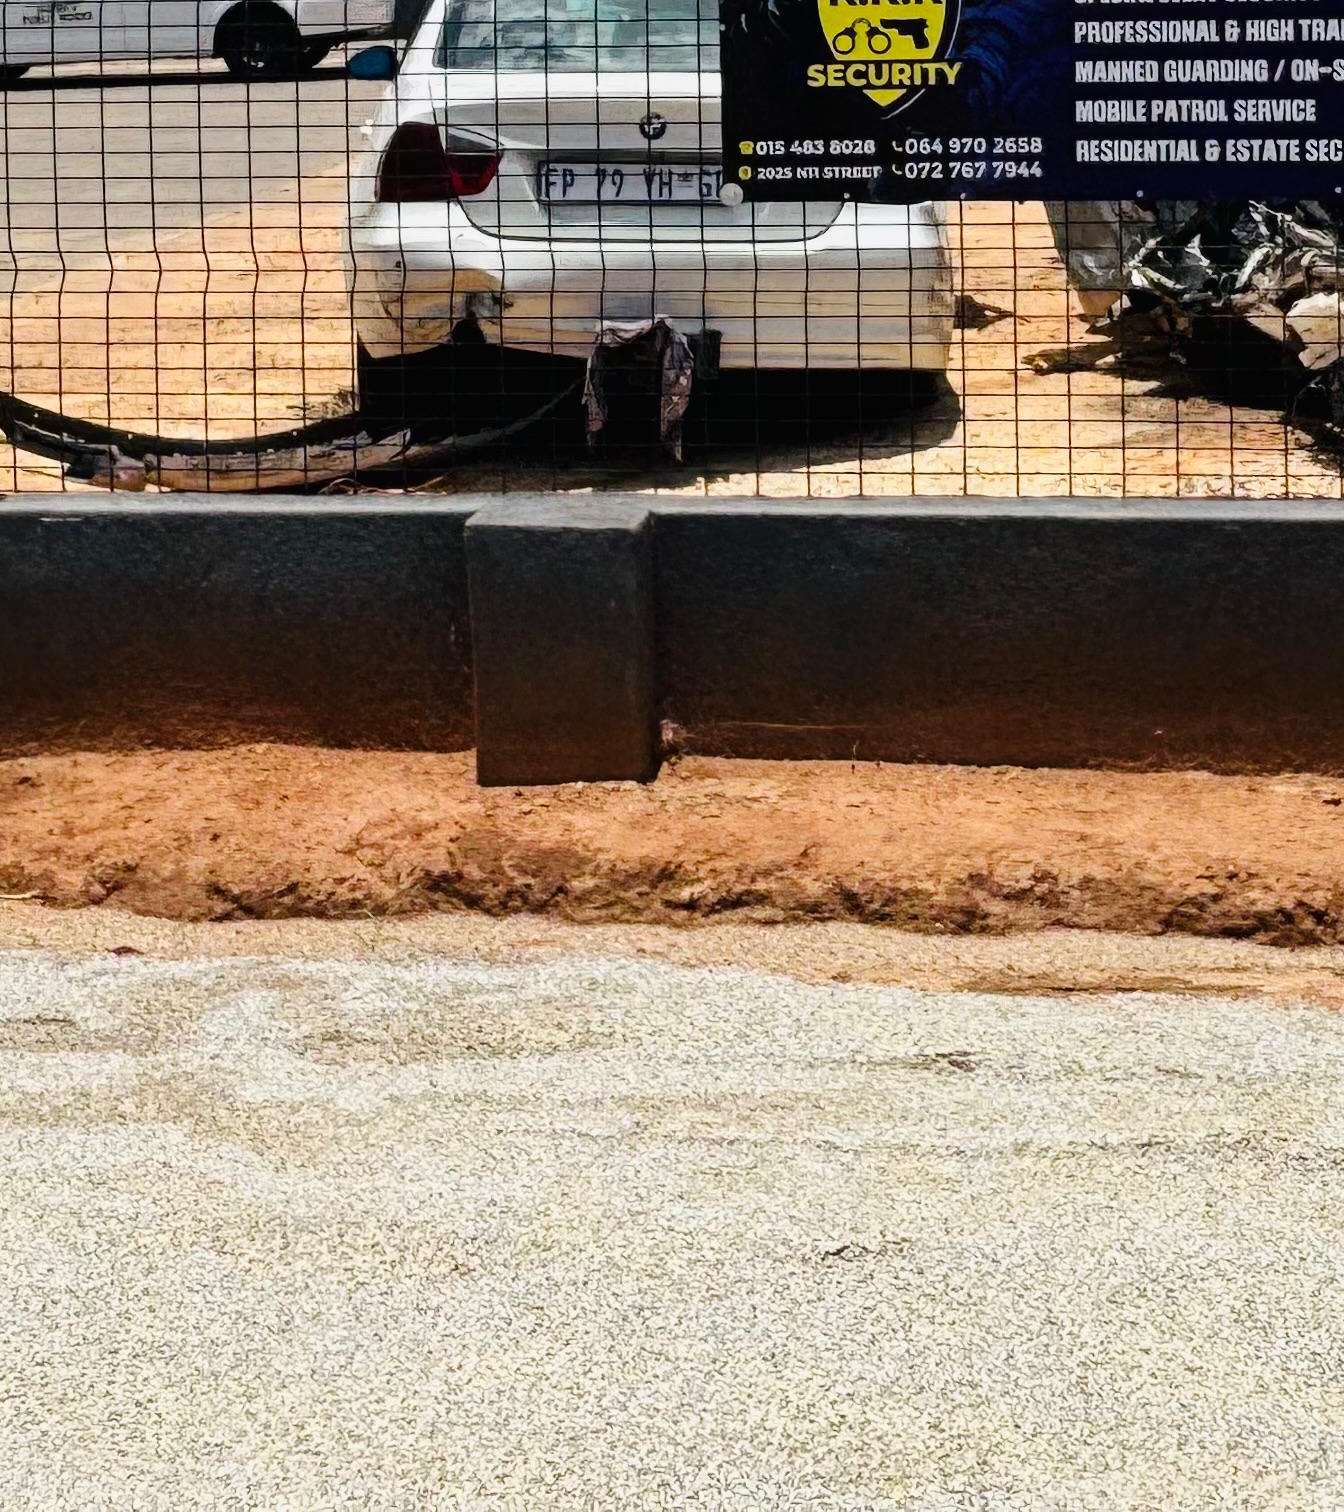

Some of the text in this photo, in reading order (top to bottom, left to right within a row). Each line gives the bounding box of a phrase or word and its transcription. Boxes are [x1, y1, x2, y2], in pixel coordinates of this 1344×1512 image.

[1074, 20, 1220, 43] PROFESSIONAL
[1224, 20, 1240, 42] &
[1245, 19, 1295, 42] HIGH
[806, 62, 963, 88] SECURITY
[1075, 61, 1159, 83] MANNED
[1163, 59, 1269, 82] GUARDING
[1273, 59, 1286, 82] /
[1075, 99, 1317, 122] MOBILE PATROL SERVICE
[756, 140, 785, 155] 015
[905, 137, 1043, 155] 064 970 2658
[1076, 140, 1200, 162] RESIDENTIAL
[1205, 140, 1222, 162] &
[1225, 140, 1301, 162] ESTATE
[757, 167, 793, 180] 2025
[822, 166, 882, 179] STREET
[904, 161, 1043, 179] 072 767 7944
